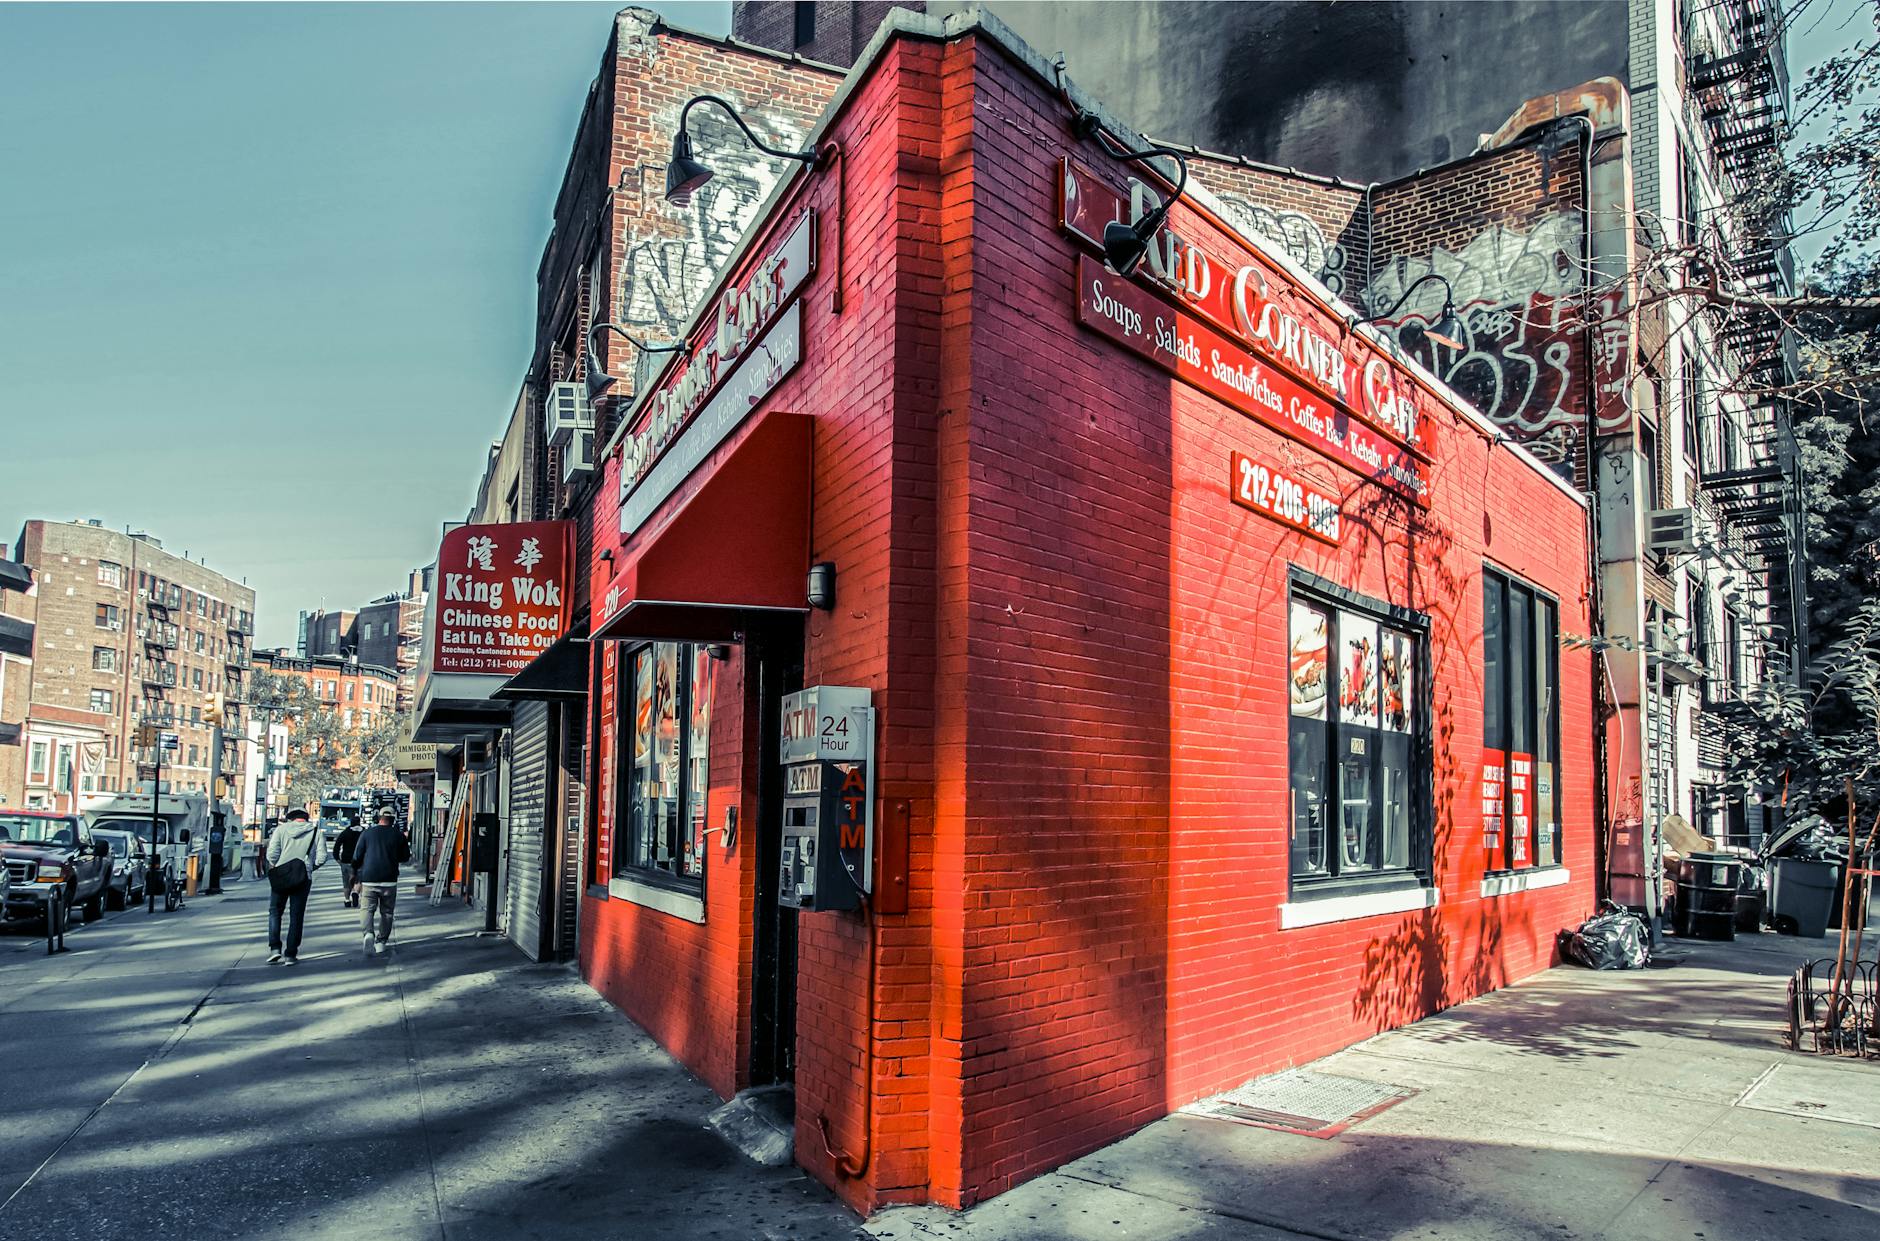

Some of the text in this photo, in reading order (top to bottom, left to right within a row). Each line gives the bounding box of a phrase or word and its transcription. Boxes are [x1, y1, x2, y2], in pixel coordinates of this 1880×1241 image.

[1235, 265, 1347, 396] CORNER
[1093, 279, 1142, 336] Soups
[1155, 316, 1201, 370] Salads
[1211, 349, 1283, 414] Sandwiches
[1290, 396, 1325, 437] Coffee
[1325, 416, 1343, 449] Bar
[1350, 431, 1382, 470] Kebabs
[445, 573, 561, 609] King Wok
[604, 585, 619, 619] 220
[443, 609, 559, 630] Chinese Food
[441, 645, 475, 655] Szechuan,
[476, 647, 511, 656] Cantonese
[512, 648, 518, 656] &
[442, 629, 557, 647] Eat In & Take Out
[441, 657, 458, 667] Tel:
[460, 658, 484, 668] (212)
[783, 705, 816, 741] ATM
[821, 715, 849, 737] 24
[821, 737, 849, 751] Hour
[791, 766, 819, 791] ATM
[840, 768, 865, 849] ATM
